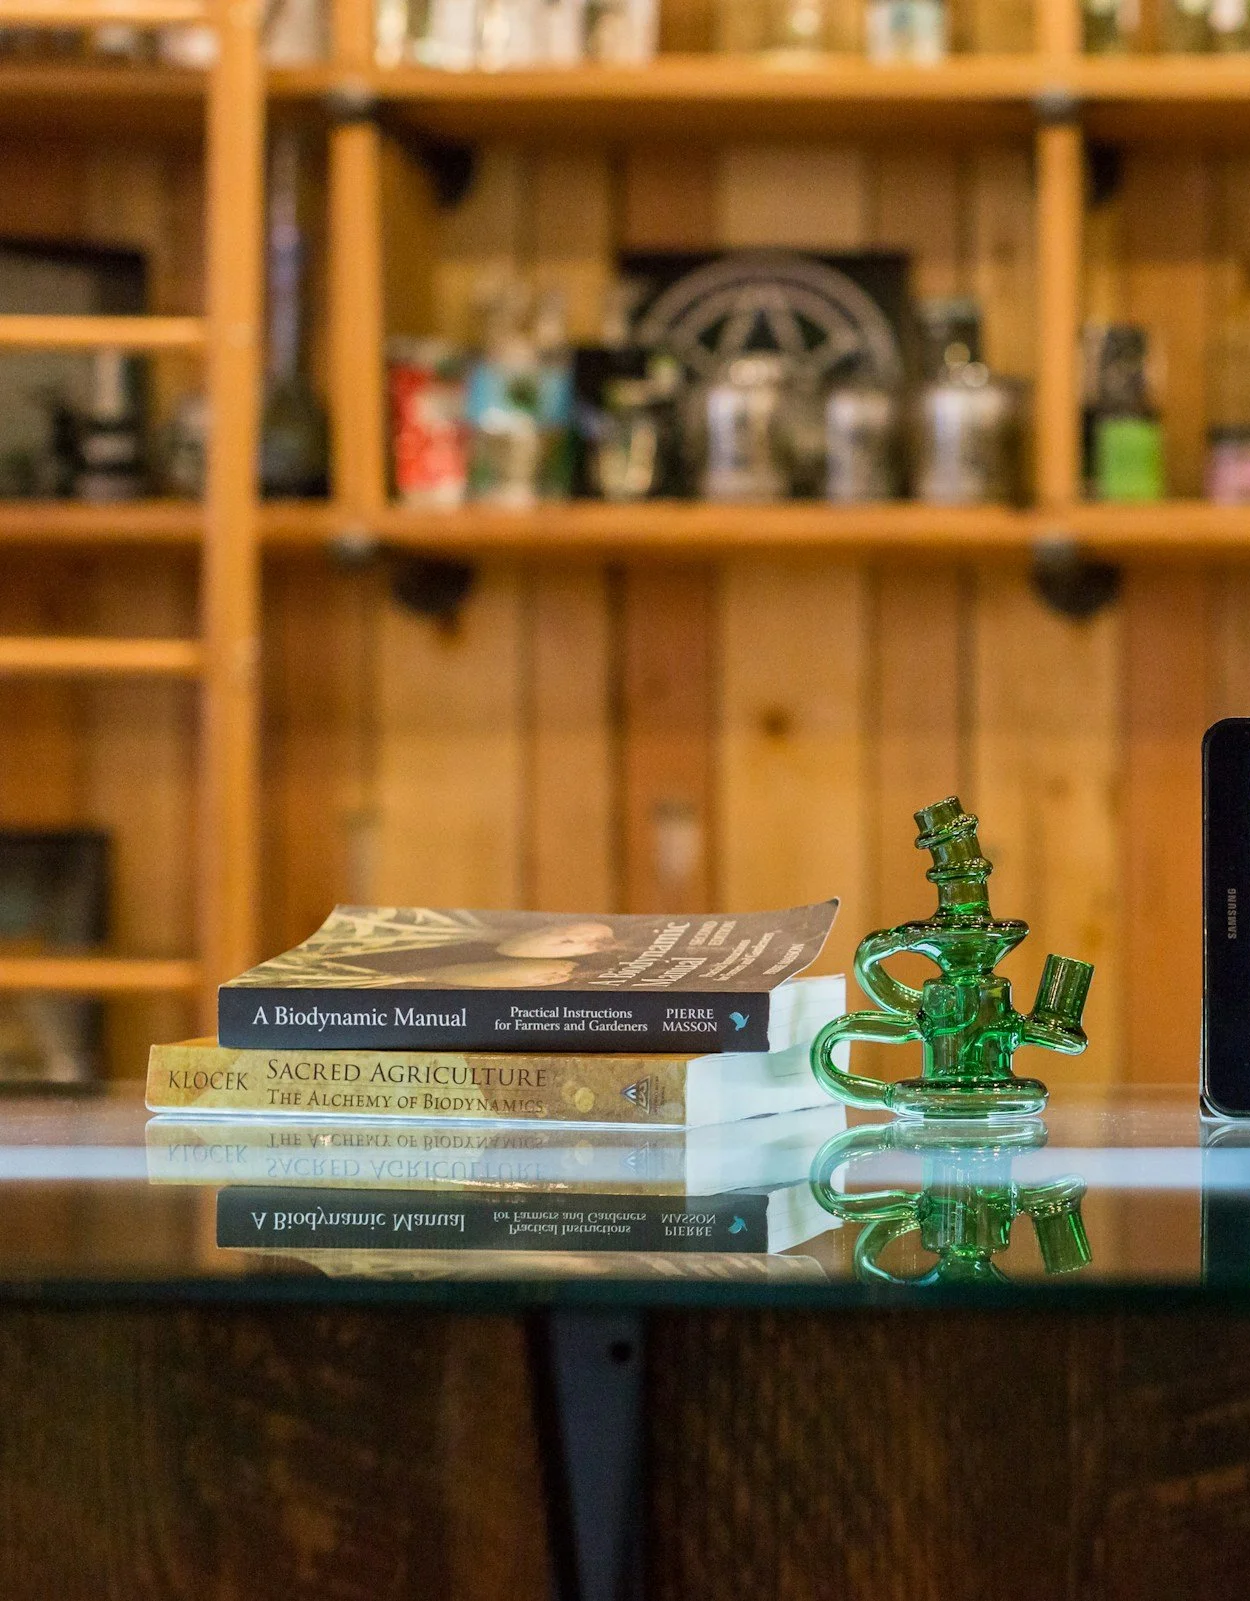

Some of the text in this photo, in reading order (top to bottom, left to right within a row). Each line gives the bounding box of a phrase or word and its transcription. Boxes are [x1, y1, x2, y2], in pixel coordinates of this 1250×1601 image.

[1227, 888, 1237, 939] SAMSUNG
[597, 922, 691, 979] Biodynamic
[588, 979, 627, 987] A
[632, 957, 708, 987] Manual
[252, 1006, 467, 1032] A Biodynamic Manual
[510, 1006, 633, 1019] Practical Instructions
[666, 1008, 714, 1020] PIERRE
[494, 1019, 648, 1032] for Farmers and Gardeners
[662, 1021, 718, 1032] MASSON
[168, 1070, 249, 1091] KLOCEK
[266, 1058, 548, 1088] SACRED AGRICULTURE
[266, 1088, 544, 1113] THE ALCHEMY OF BIODYNAMICS
